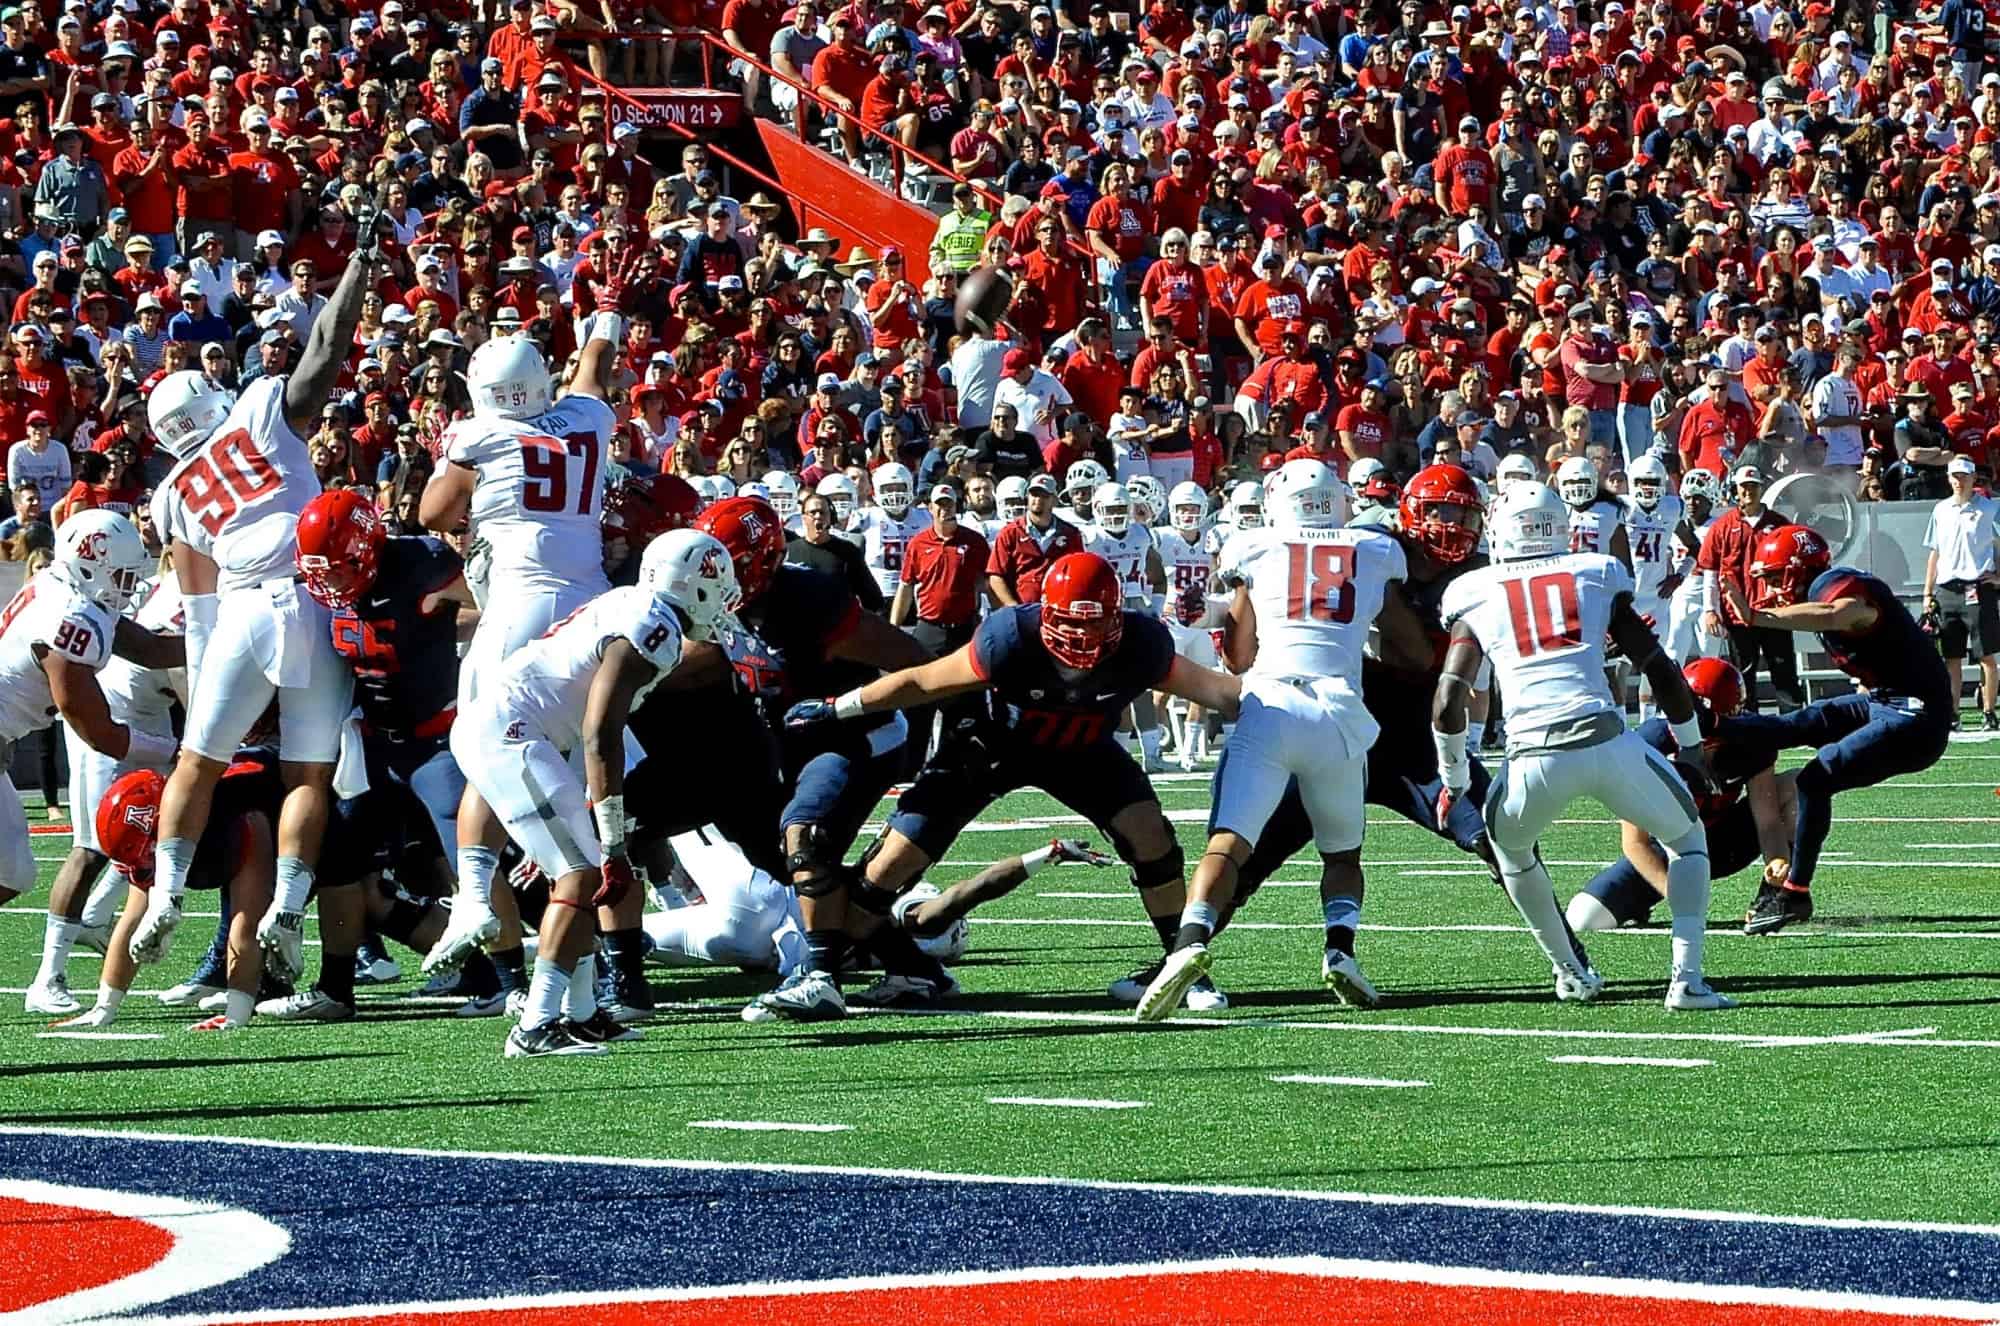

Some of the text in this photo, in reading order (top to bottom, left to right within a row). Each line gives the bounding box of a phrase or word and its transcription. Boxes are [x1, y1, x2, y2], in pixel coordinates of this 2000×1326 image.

[625, 103, 685, 123] SECTION
[690, 104, 704, 124] 21
[512, 391, 528, 407] 97
[178, 416, 196, 434] 90
[174, 426, 284, 538] 90
[516, 430, 599, 515] 97
[1319, 500, 1331, 515] 18
[1541, 522, 1553, 537] 10
[1635, 532, 1662, 563] 41
[1286, 543, 1357, 625] 18
[1503, 571, 1582, 658] 10
[54, 620, 92, 658] 99
[643, 622, 670, 652] 8
[124, 804, 157, 834] A
